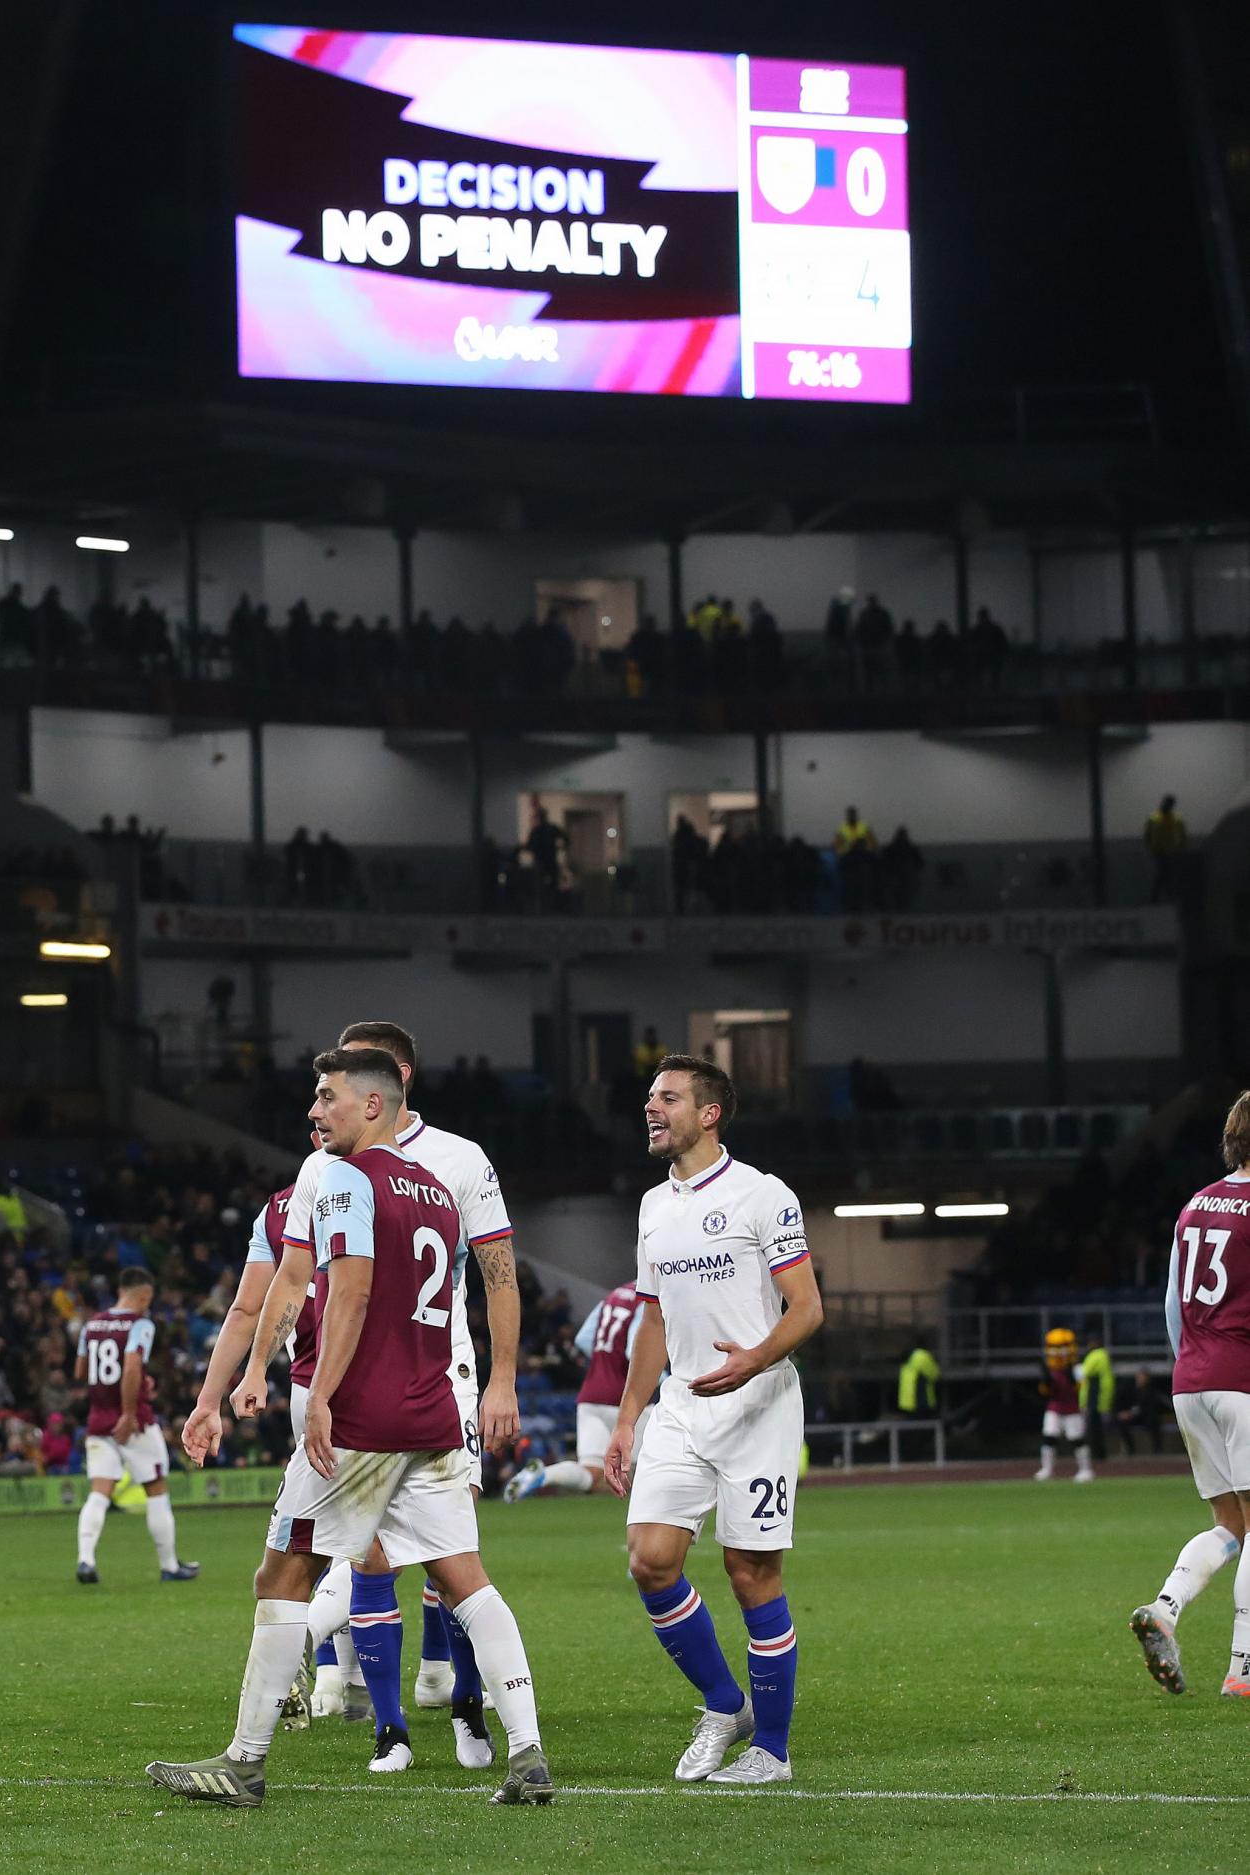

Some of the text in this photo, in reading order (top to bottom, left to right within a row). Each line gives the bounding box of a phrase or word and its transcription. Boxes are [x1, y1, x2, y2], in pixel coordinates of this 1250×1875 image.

[384, 158, 604, 215] DECISION
[846, 146, 887, 217] 0
[321, 207, 668, 277] NO PENALTY
[856, 258, 881, 313] 4
[388, 1175, 453, 1212] LOWTON
[411, 1226, 450, 1329] 2
[656, 1252, 734, 1277] YOKOHAMA
[699, 1267, 735, 1284] TYRES
[1182, 1226, 1232, 1306] 13
[595, 1303, 632, 1354] 17
[87, 1338, 122, 1386] 18
[750, 1475, 788, 1519] 28
[503, 1676, 532, 1691] BFC
